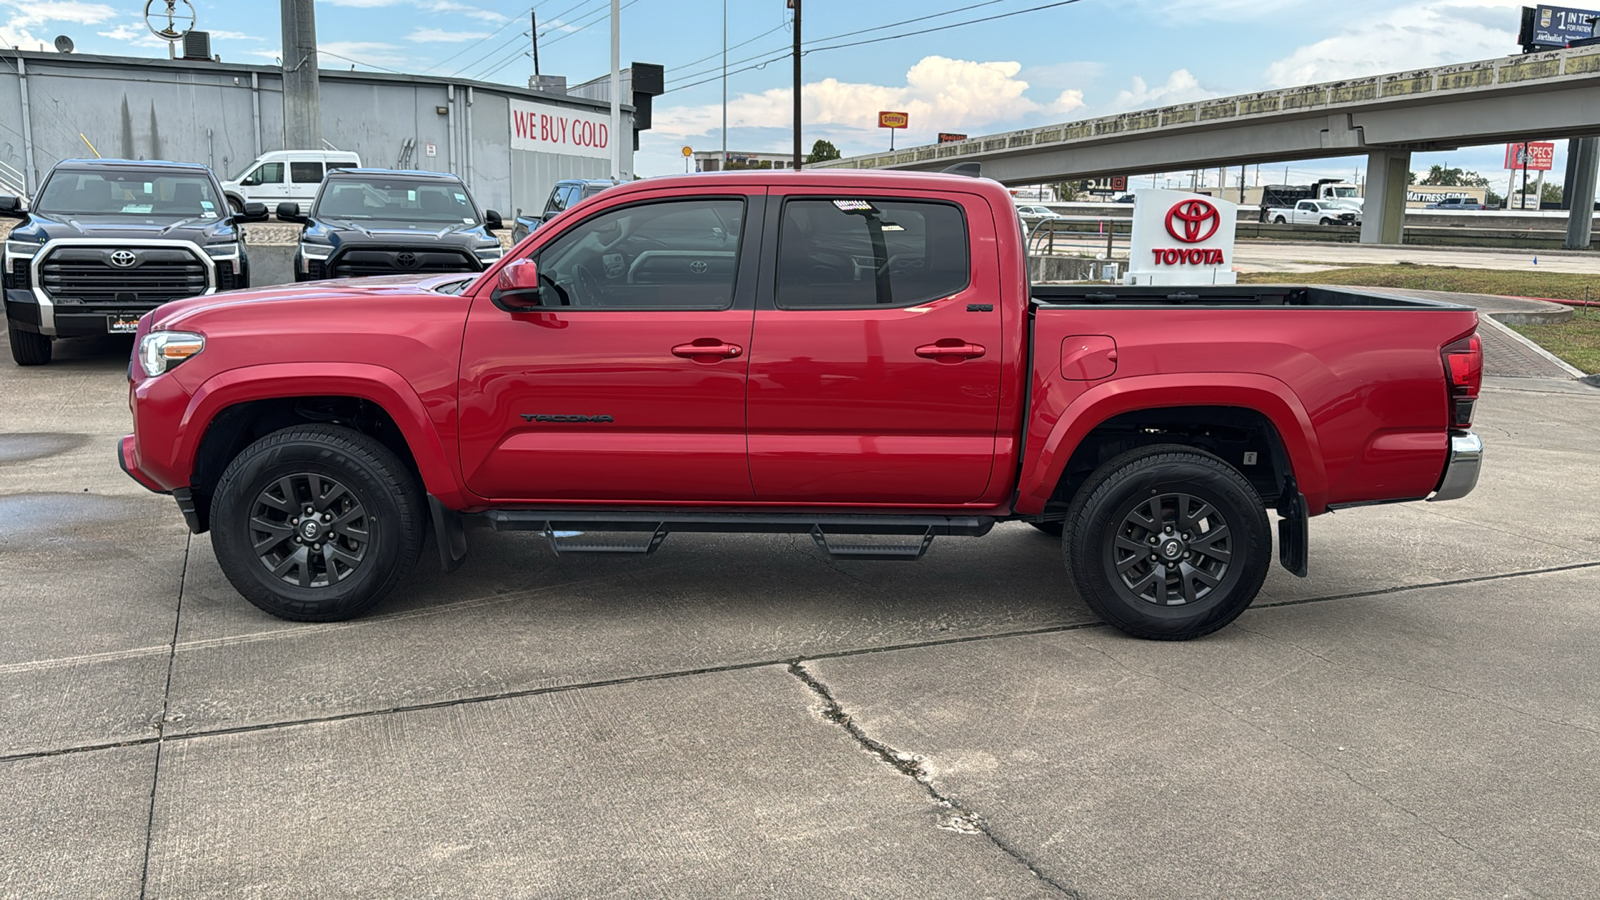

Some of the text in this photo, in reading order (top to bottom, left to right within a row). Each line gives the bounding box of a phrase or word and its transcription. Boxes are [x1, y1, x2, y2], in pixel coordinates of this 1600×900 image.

[1567, 12, 1577, 23] IN
[884, 115, 905, 124] Denny's
[514, 110, 608, 149] WE BUY GOLD
[1086, 177, 1112, 190] 5.11
[1406, 191, 1446, 202] MATTRESS
[1152, 248, 1224, 265] TOYOTA
[520, 413, 613, 423] TACOMA
